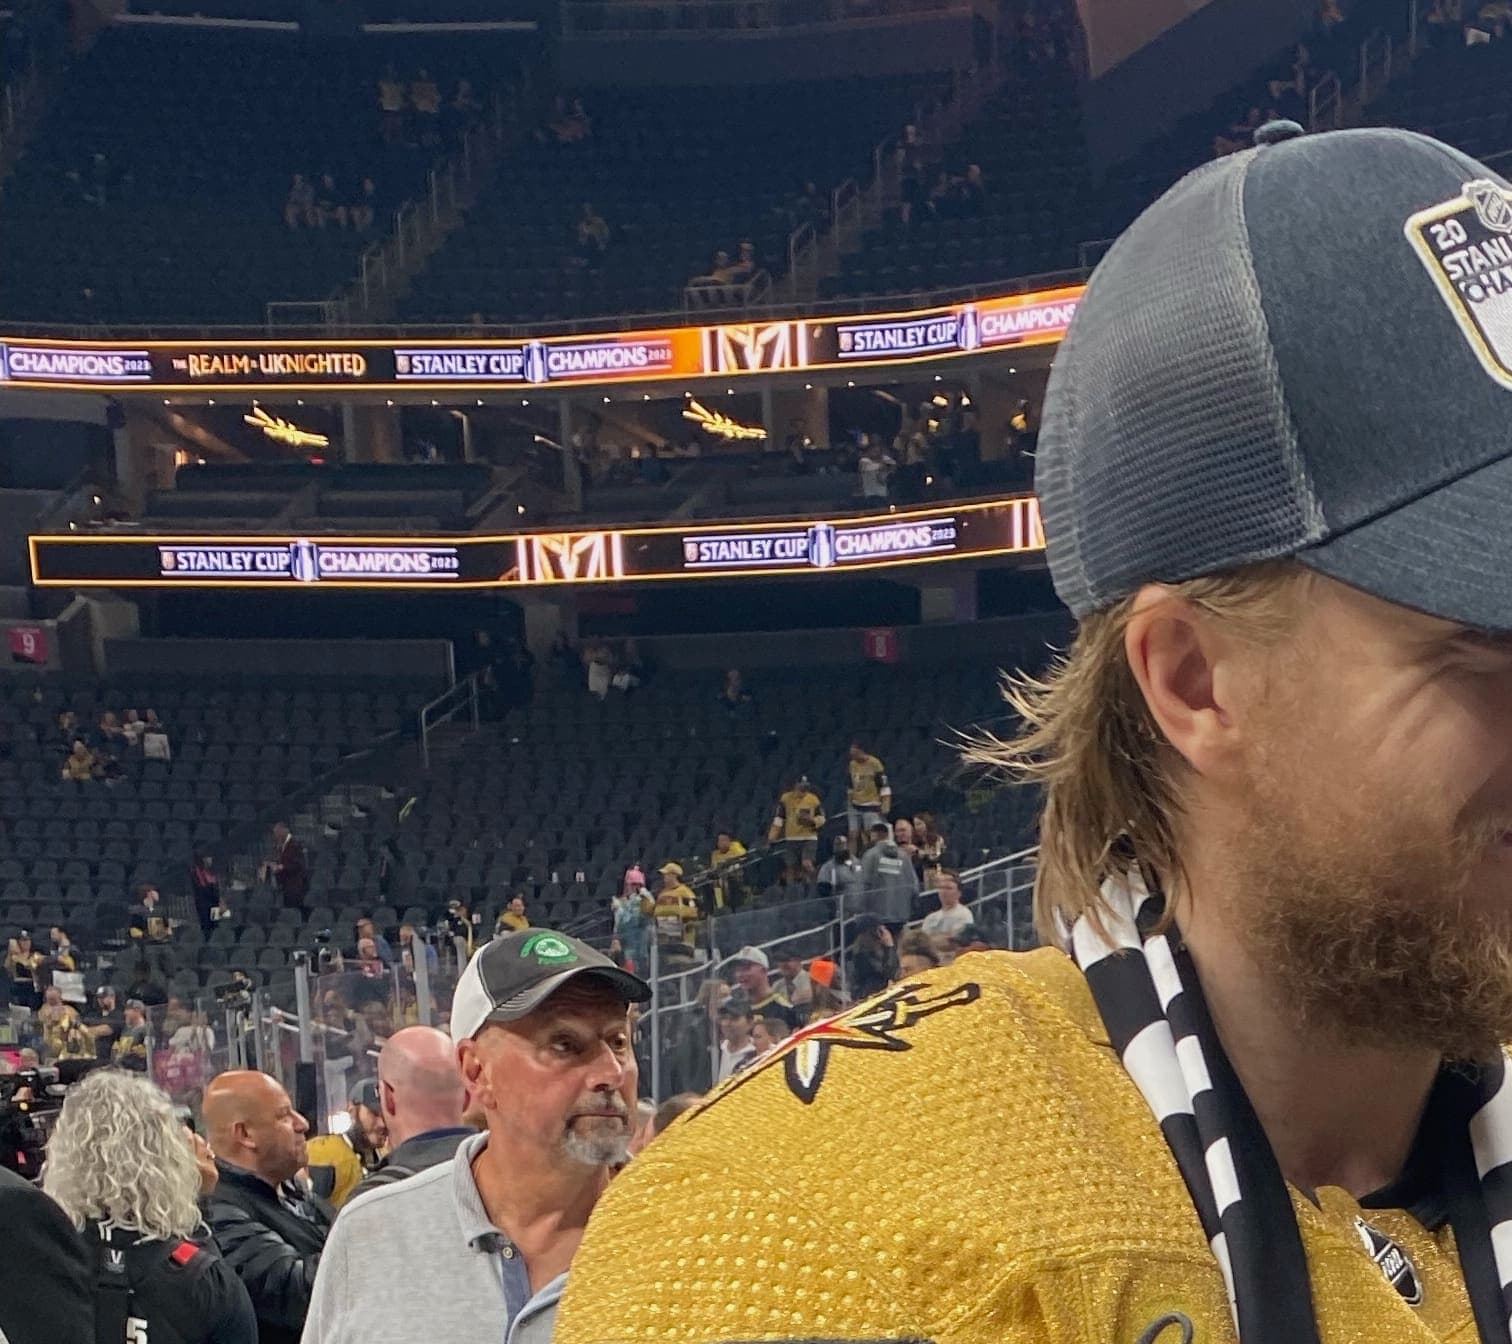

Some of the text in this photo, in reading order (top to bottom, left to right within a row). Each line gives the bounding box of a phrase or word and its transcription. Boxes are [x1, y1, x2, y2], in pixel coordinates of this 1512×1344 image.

[1430, 218, 1468, 250] 20
[854, 303, 1077, 351] STANLEY CUP CHAMPIONS
[9, 353, 124, 375] CHAMPIONS
[189, 354, 250, 377] REALM
[259, 353, 367, 377] UKNIGHTED
[413, 355, 486, 374] STANLEY
[491, 354, 523, 373] CUP
[549, 346, 649, 371] CHAMPIONS
[700, 540, 773, 561] STANLEY
[774, 538, 808, 558] CUP
[835, 526, 932, 554] CHAMPIONS
[177, 552, 253, 571] STANLEY
[255, 552, 290, 571] CUP
[318, 552, 430, 573] CHAMPIONS
